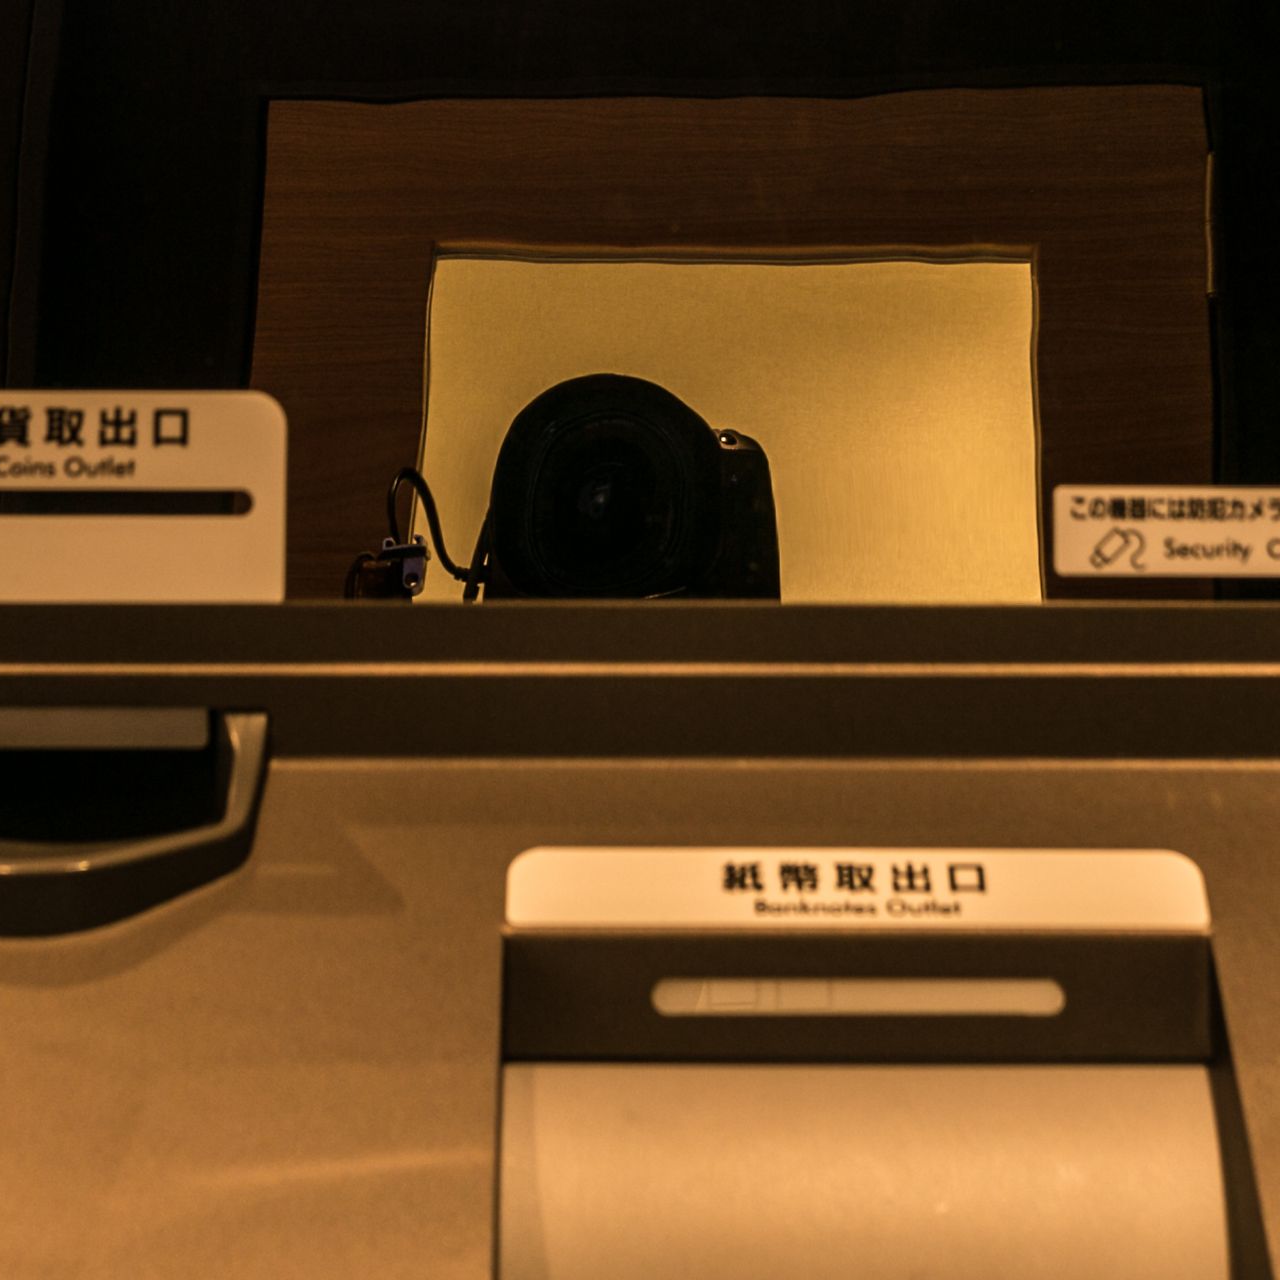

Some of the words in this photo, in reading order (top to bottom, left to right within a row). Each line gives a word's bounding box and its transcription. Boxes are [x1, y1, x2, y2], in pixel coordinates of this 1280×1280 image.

[64, 456, 136, 478] Outlet
[1163, 537, 1253, 564] Security
[721, 860, 989, 895] 紙幣取出口
[754, 898, 878, 916] Banknotes
[886, 899, 962, 917] Outlet
